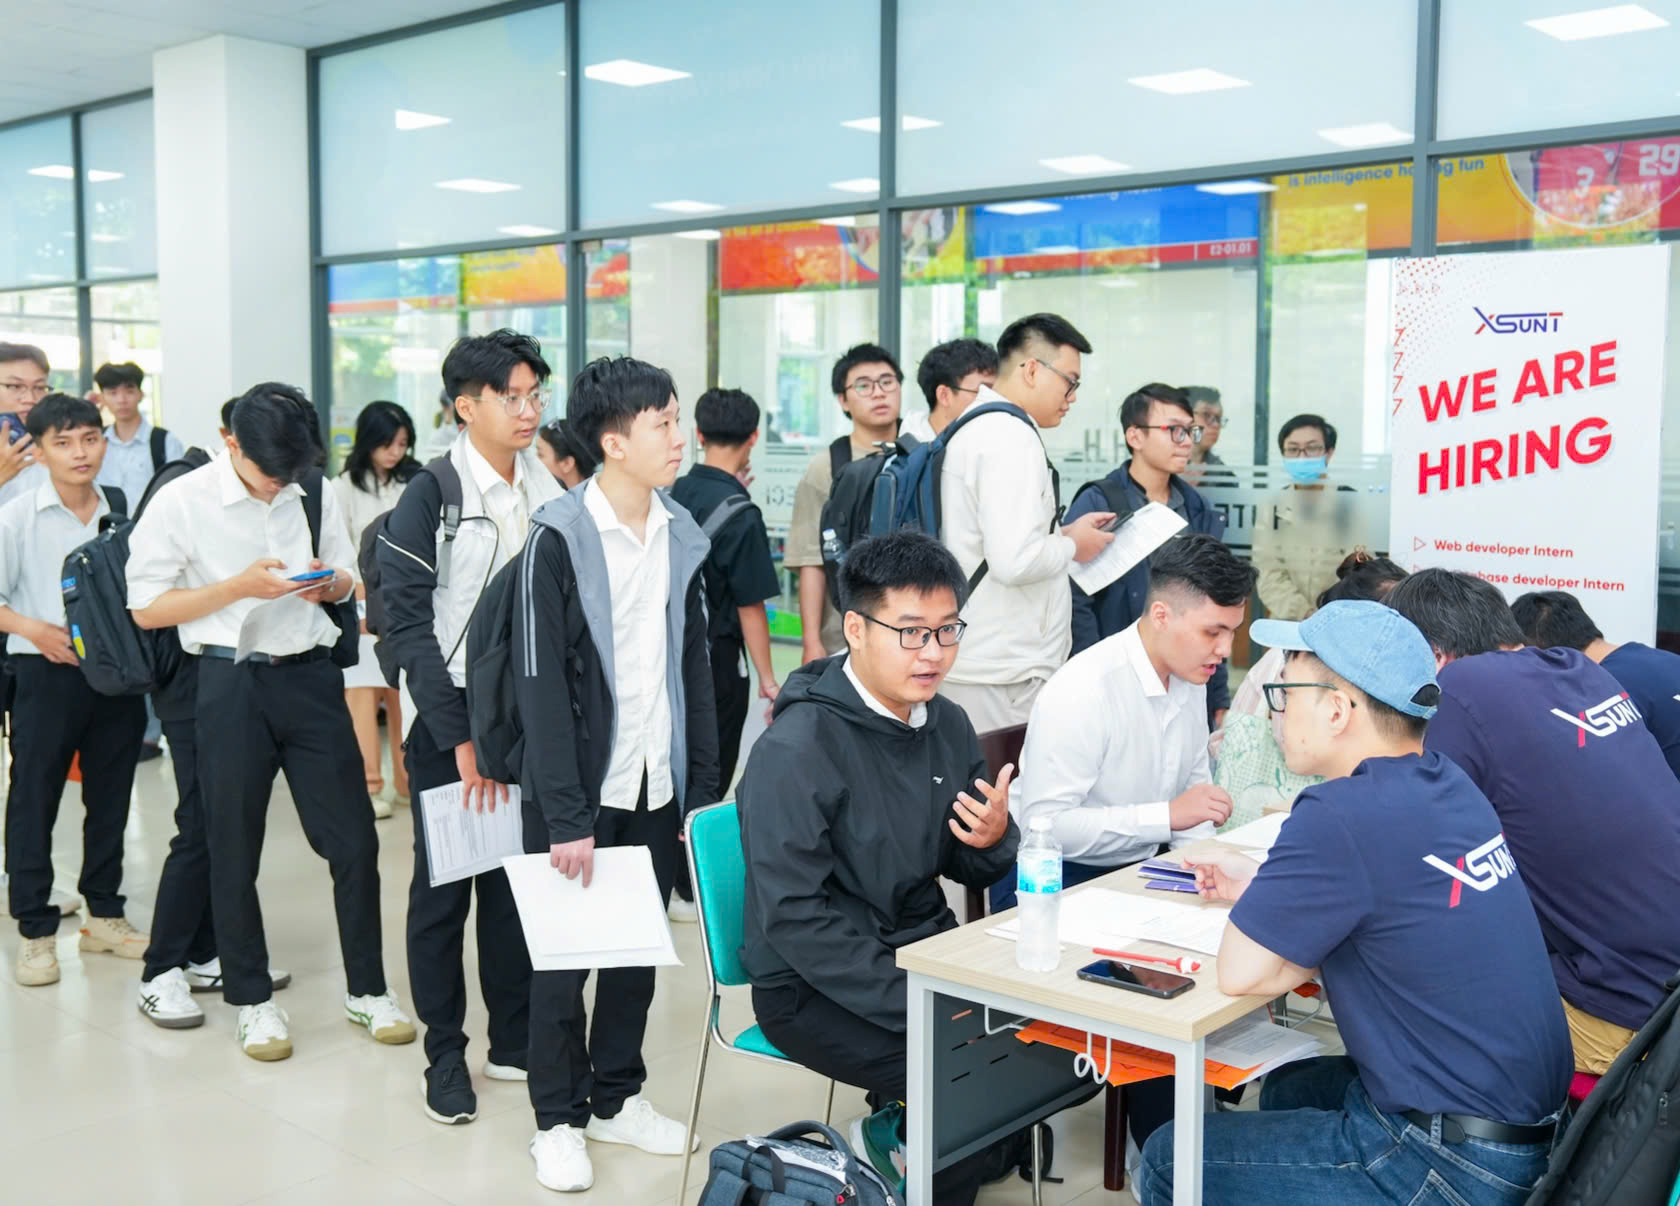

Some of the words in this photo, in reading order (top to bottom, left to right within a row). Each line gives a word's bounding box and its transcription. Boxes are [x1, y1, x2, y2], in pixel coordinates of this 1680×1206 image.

[1304, 166, 1394, 186] intelligence
[1458, 158, 1485, 172] fun
[1638, 143, 1680, 176] 29
[1418, 368, 1498, 423] WE
[1512, 340, 1617, 405] ARE
[1418, 417, 1612, 495] HIRING
[1434, 540, 1462, 552] Web
[1465, 542, 1530, 556] developer
[1534, 545, 1574, 558] Intern
[1513, 573, 1579, 589] developer
[1583, 577, 1625, 592] Intern
